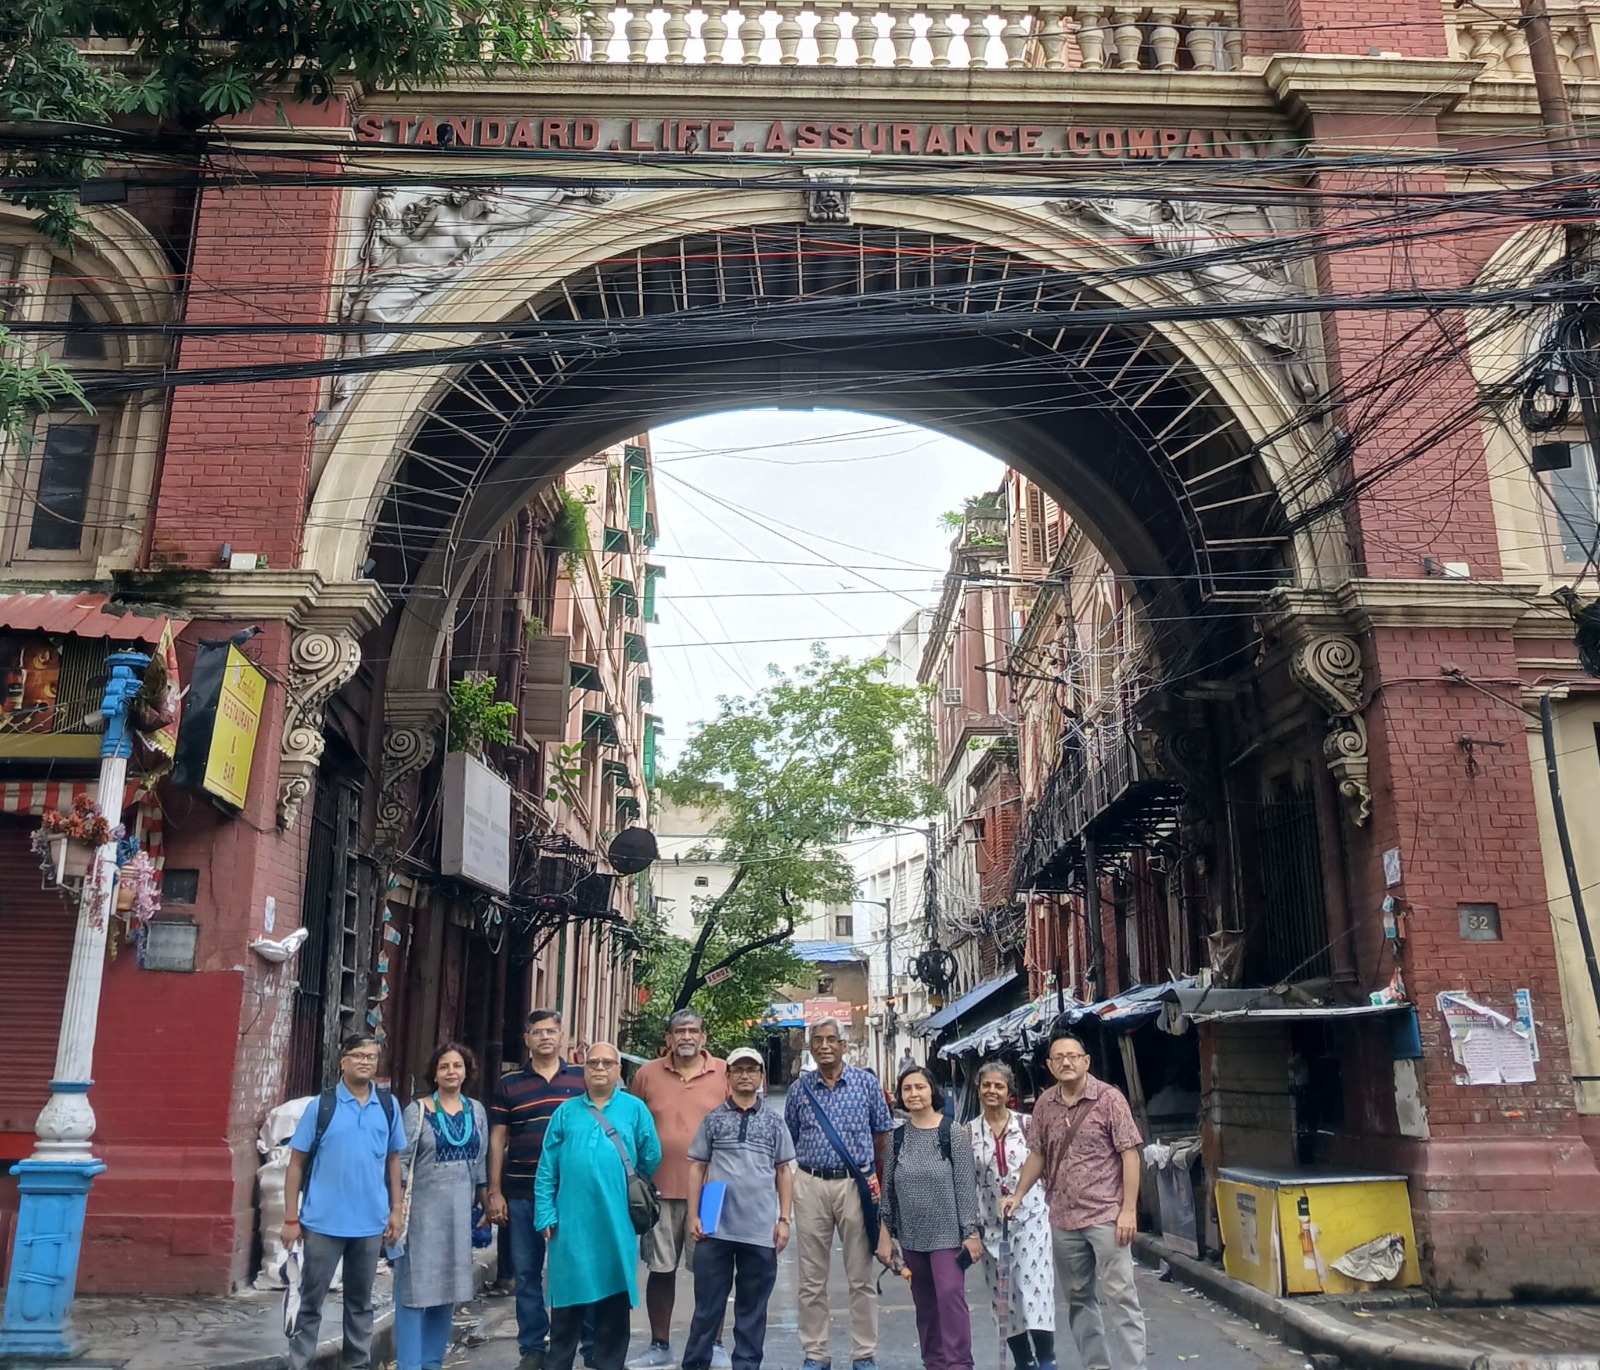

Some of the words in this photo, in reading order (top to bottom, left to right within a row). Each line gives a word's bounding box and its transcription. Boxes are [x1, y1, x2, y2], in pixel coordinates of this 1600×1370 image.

[1067, 127, 1274, 158] COMPANY
[222, 761, 236, 785] BAR
[1469, 915, 1489, 930] 32
